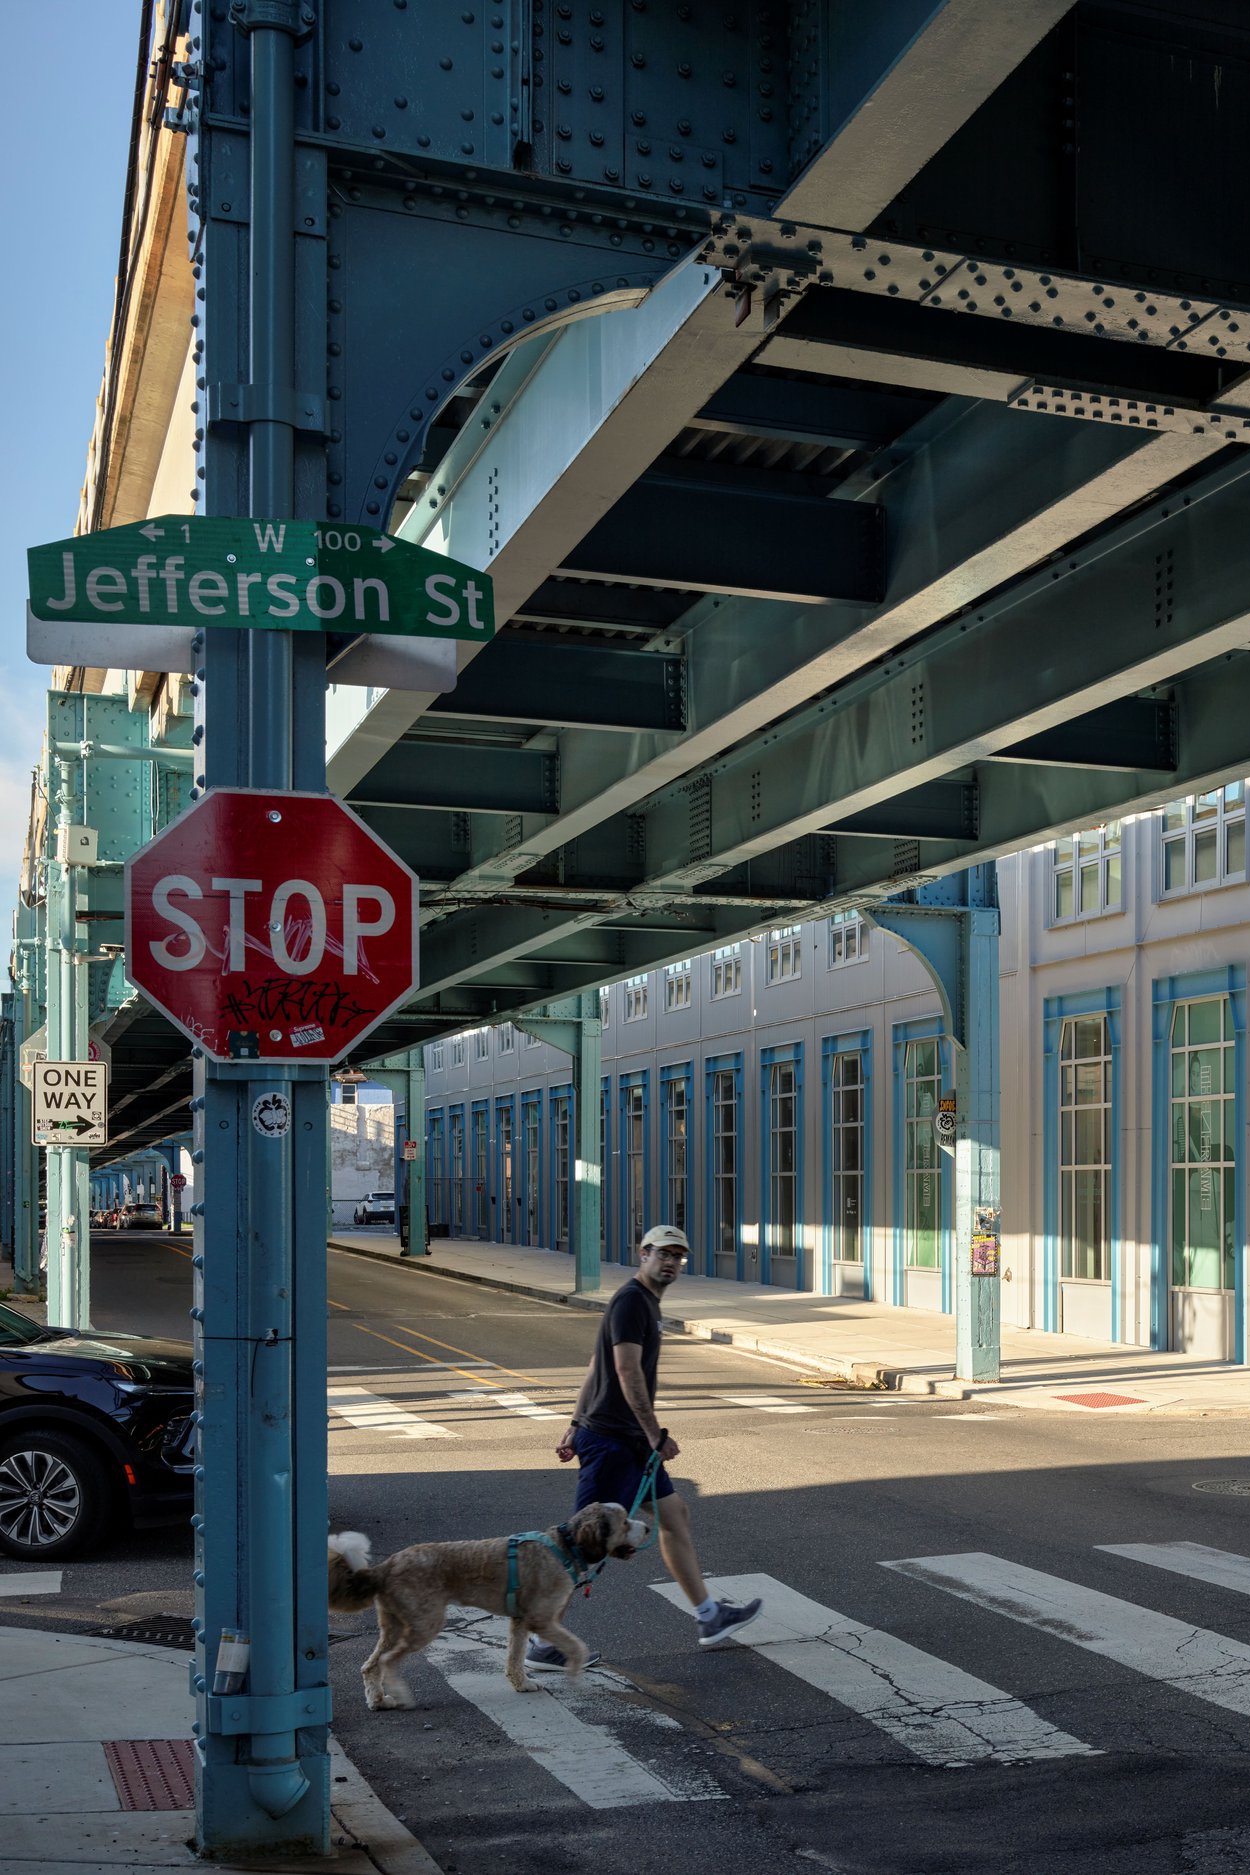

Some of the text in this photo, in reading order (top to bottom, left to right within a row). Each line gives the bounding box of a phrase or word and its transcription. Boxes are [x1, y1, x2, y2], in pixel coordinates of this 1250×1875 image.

[180, 523, 361, 553] 1 W 100
[46, 551, 484, 630] Jefferson St
[149, 874, 396, 976] STOP
[292, 1023, 316, 1034] Supreme
[43, 1069, 97, 1087] ONE
[43, 1091, 97, 1109] WAY
